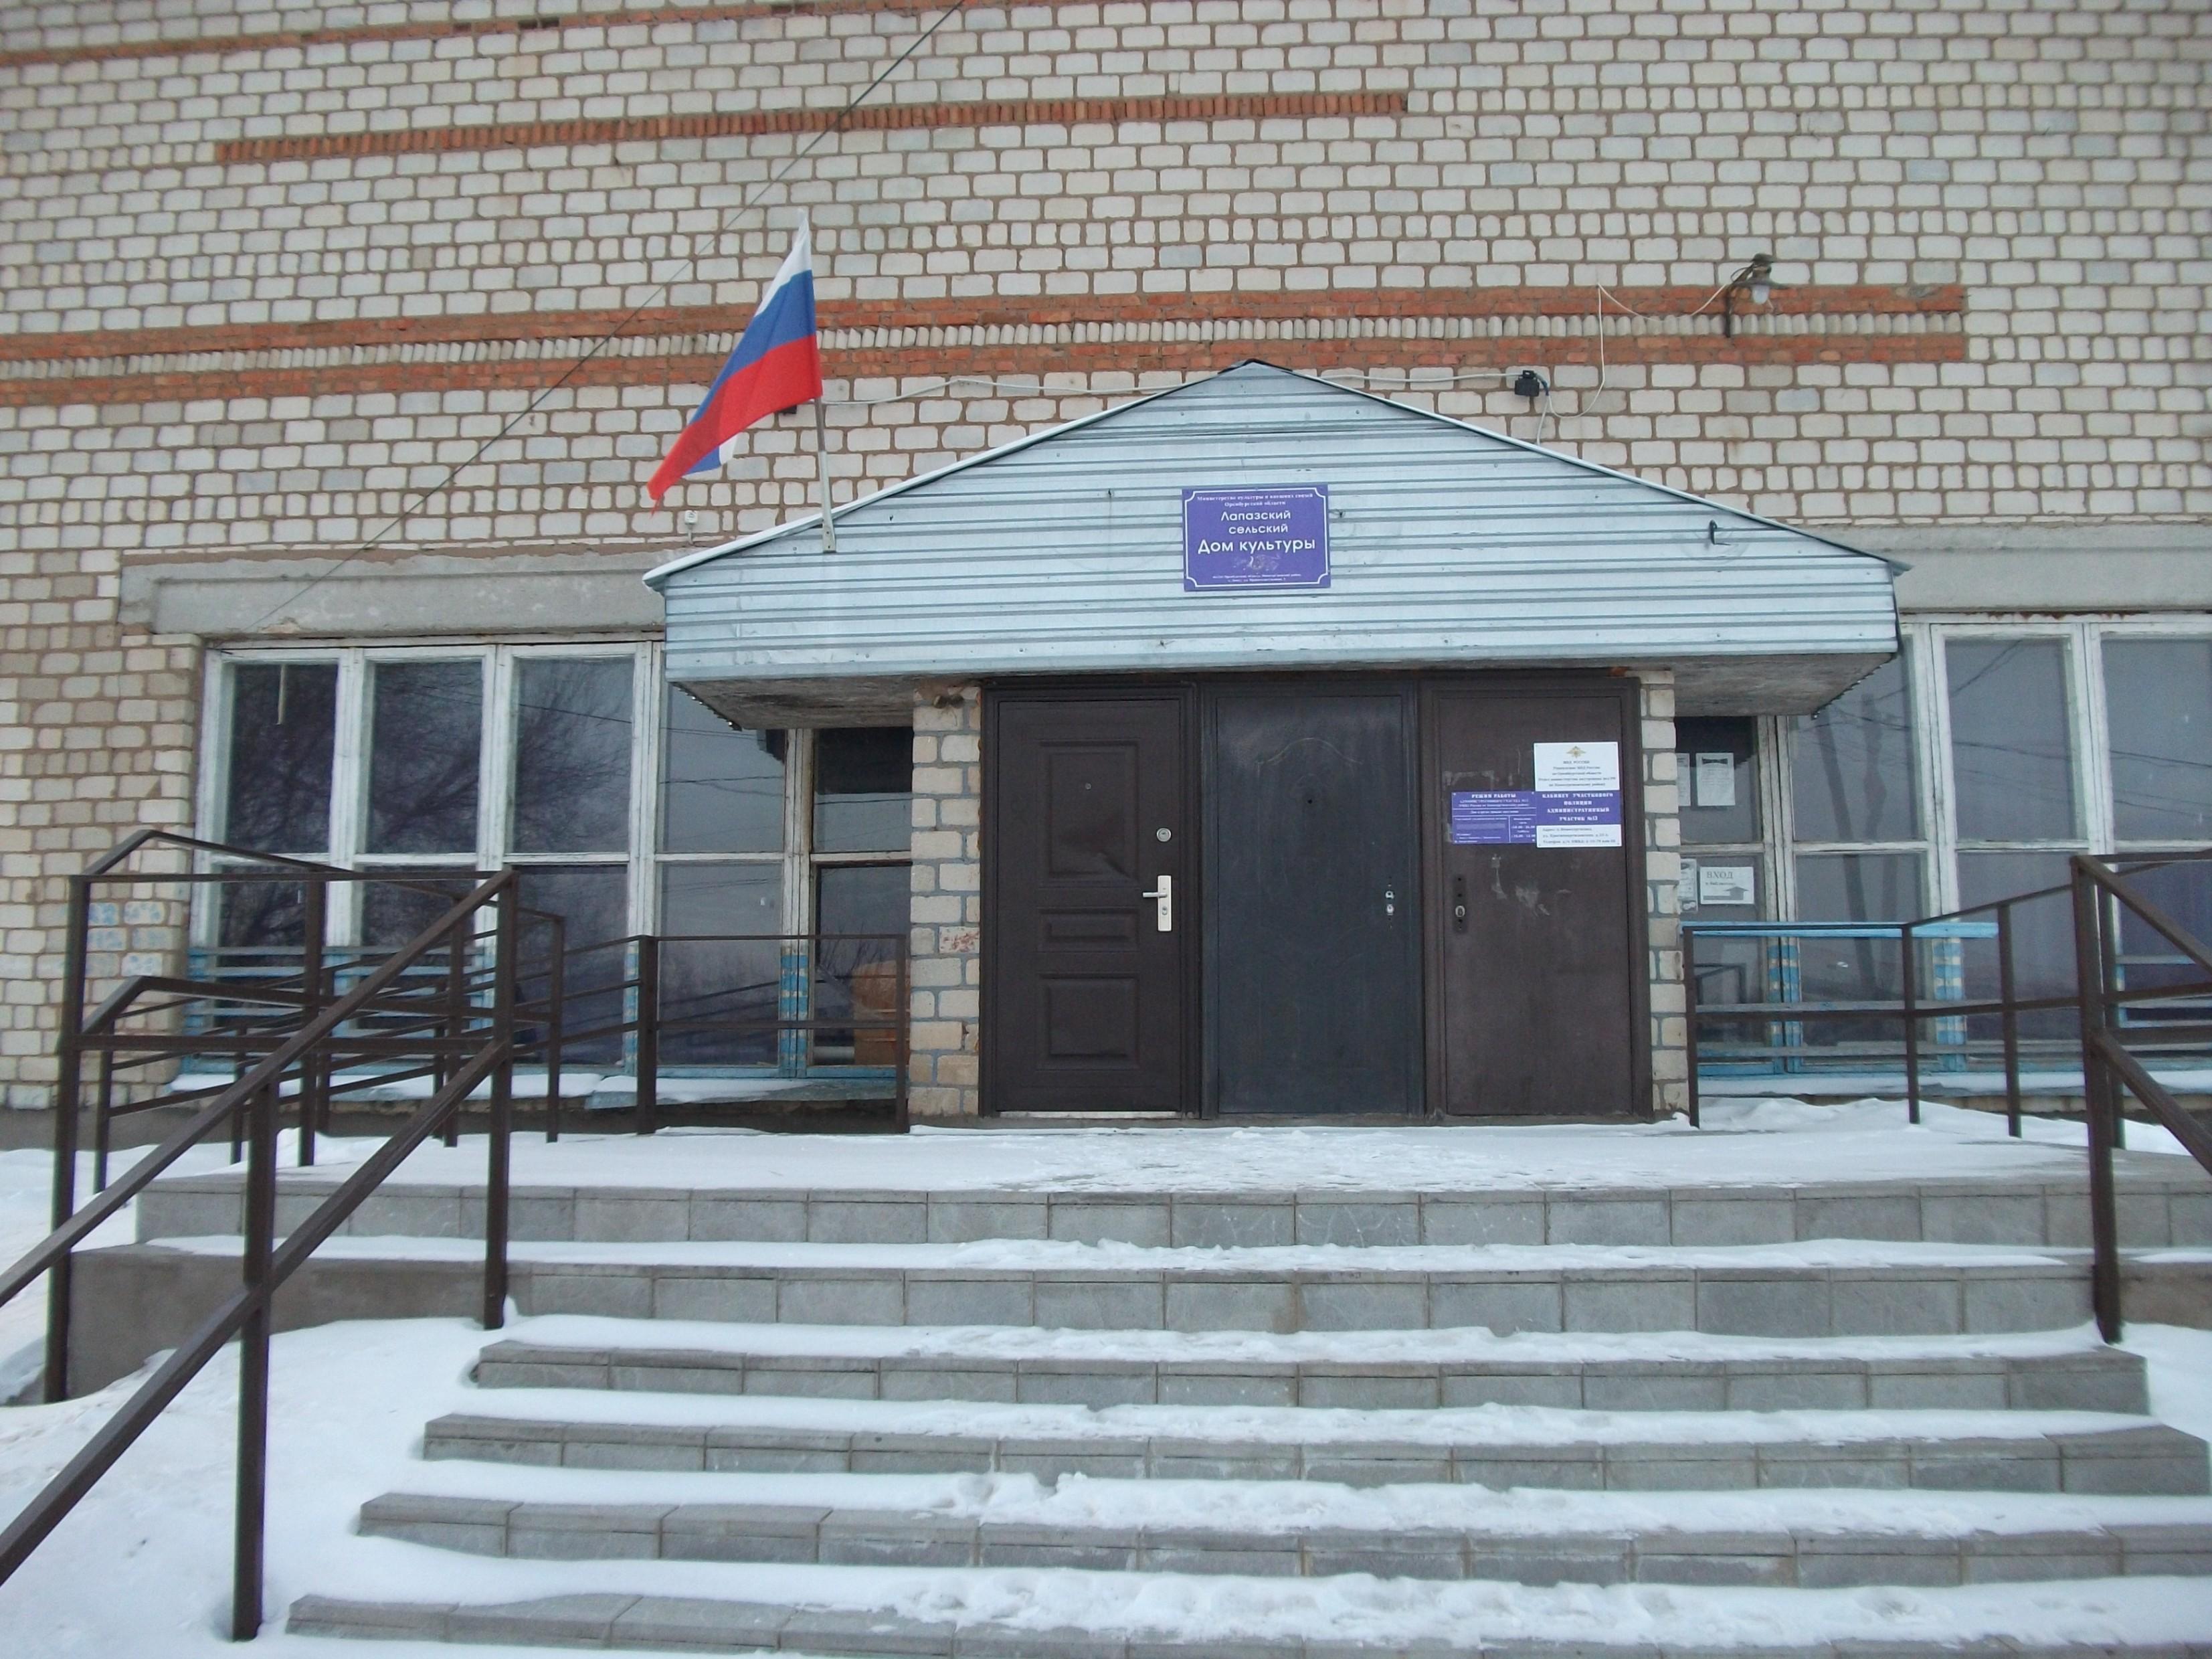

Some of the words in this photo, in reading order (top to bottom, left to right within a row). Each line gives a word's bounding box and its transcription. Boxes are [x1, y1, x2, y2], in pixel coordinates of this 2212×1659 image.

[1220, 510, 1291, 521] Лапазский
[1228, 523, 1288, 534] сельский
[1198, 539, 1234, 554] Дом
[1239, 539, 1315, 554] культуры
